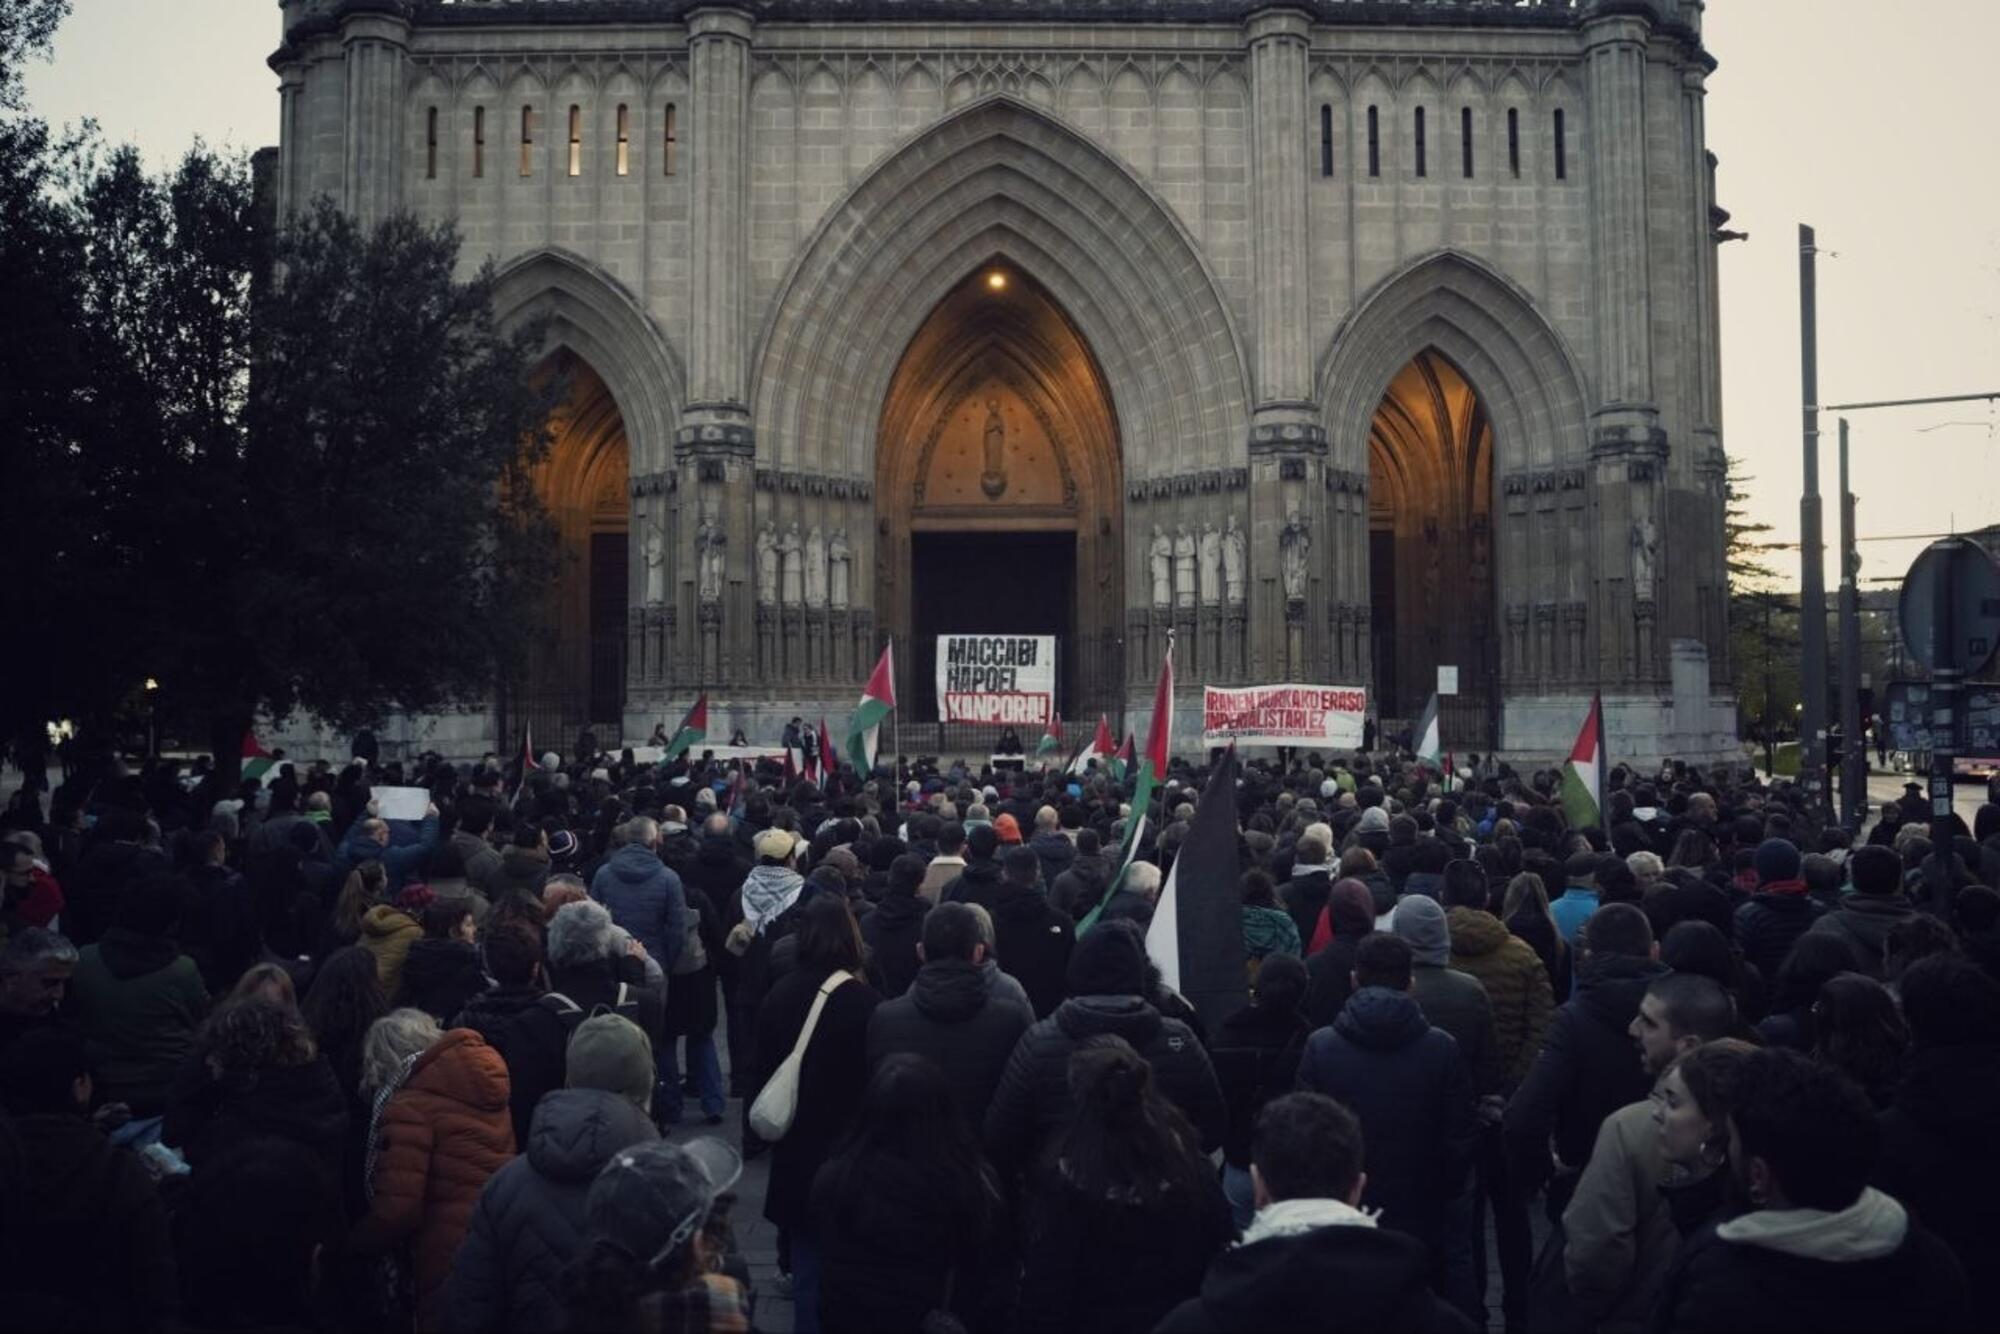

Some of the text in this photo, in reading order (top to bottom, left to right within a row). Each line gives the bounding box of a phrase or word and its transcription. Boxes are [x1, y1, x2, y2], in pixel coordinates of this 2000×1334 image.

[948, 637, 1038, 666] MACCABI
[947, 666, 1020, 692] HAPOEL
[947, 694, 1047, 723] KANPORA!
[1207, 690, 1365, 713] IRANEN AURKAKO ERASO
[1310, 710, 1326, 730] EZ
